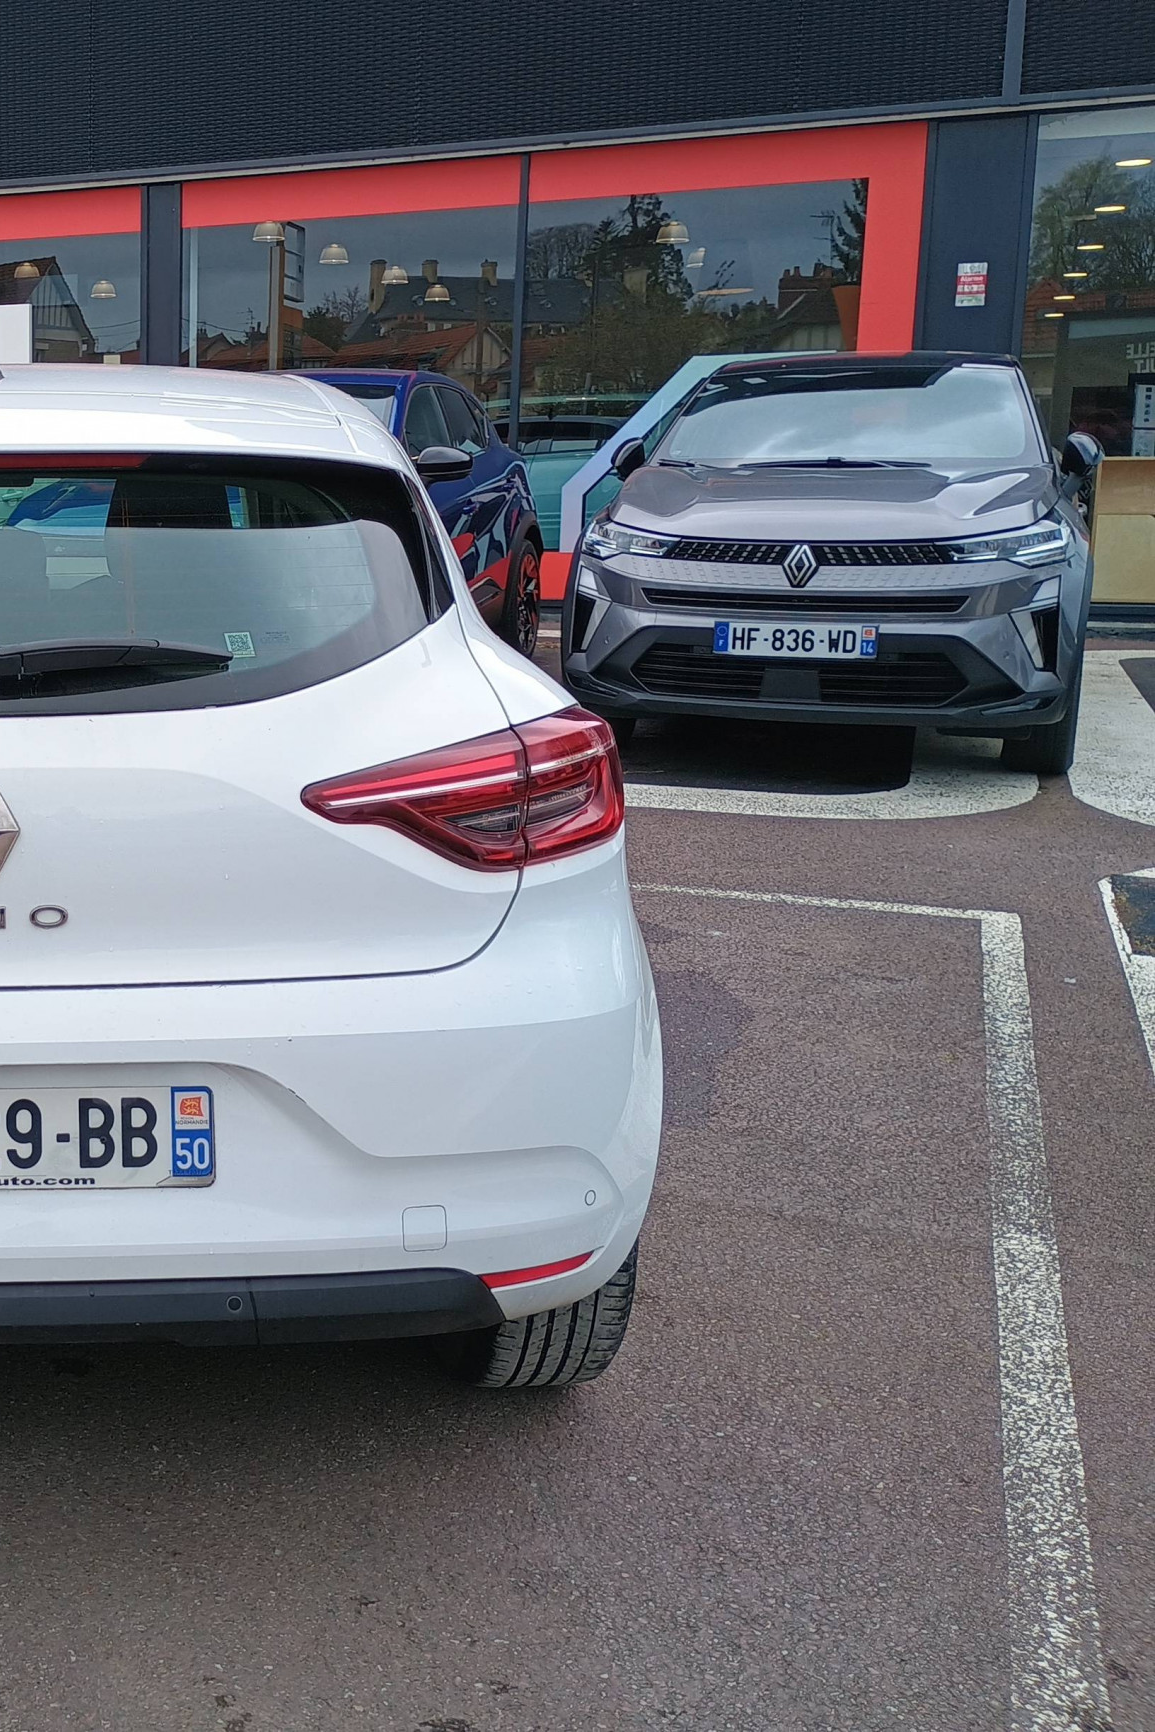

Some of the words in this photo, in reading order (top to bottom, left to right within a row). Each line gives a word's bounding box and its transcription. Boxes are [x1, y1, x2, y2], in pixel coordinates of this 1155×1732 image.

[718, 639, 725, 647] F
[732, 627, 858, 654] HF-836-WD
[861, 642, 874, 654] 14
[175, 1137, 210, 1170] 50
